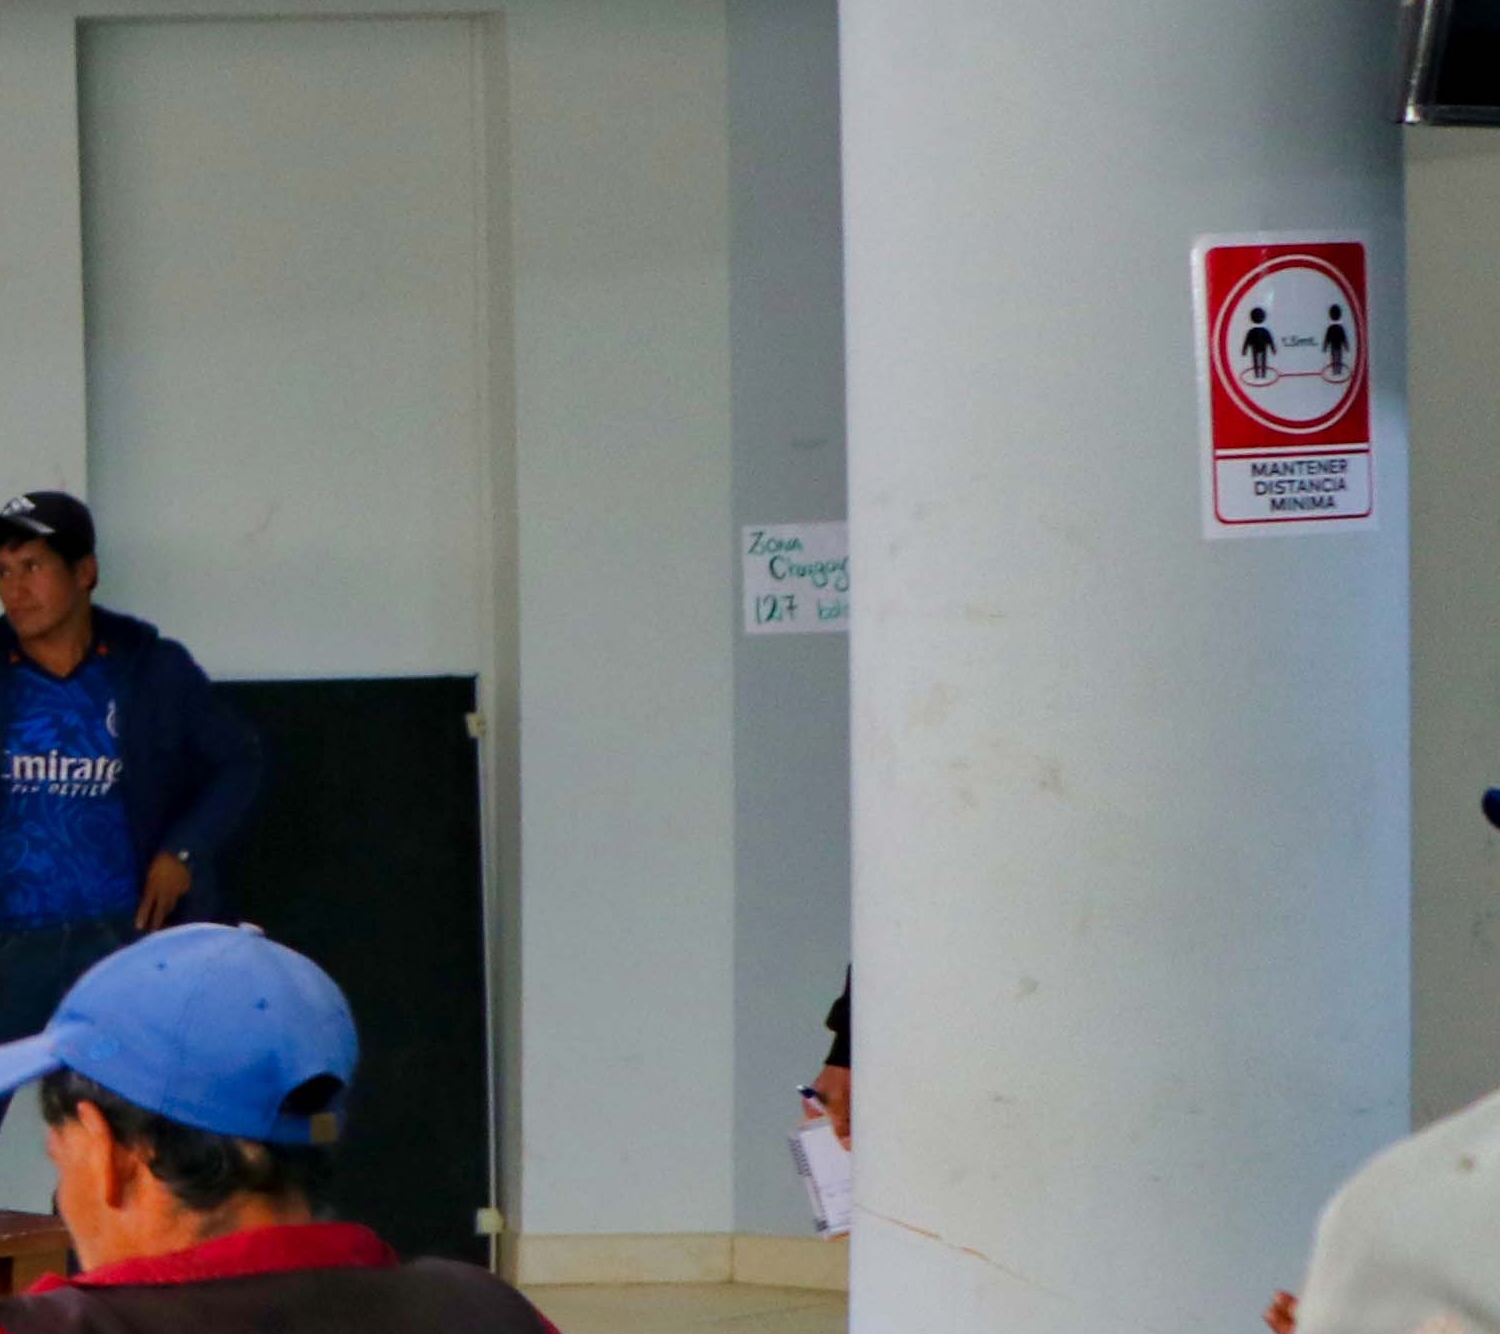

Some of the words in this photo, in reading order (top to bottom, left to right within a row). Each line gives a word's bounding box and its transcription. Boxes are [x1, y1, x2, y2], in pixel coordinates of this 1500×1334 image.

[1252, 459, 1348, 477] MANTENER
[1254, 478, 1347, 496] DISTANCIA
[1270, 496, 1336, 513] MINIMA
[756, 593, 798, 624] 127
[1, 748, 123, 782] mirate
